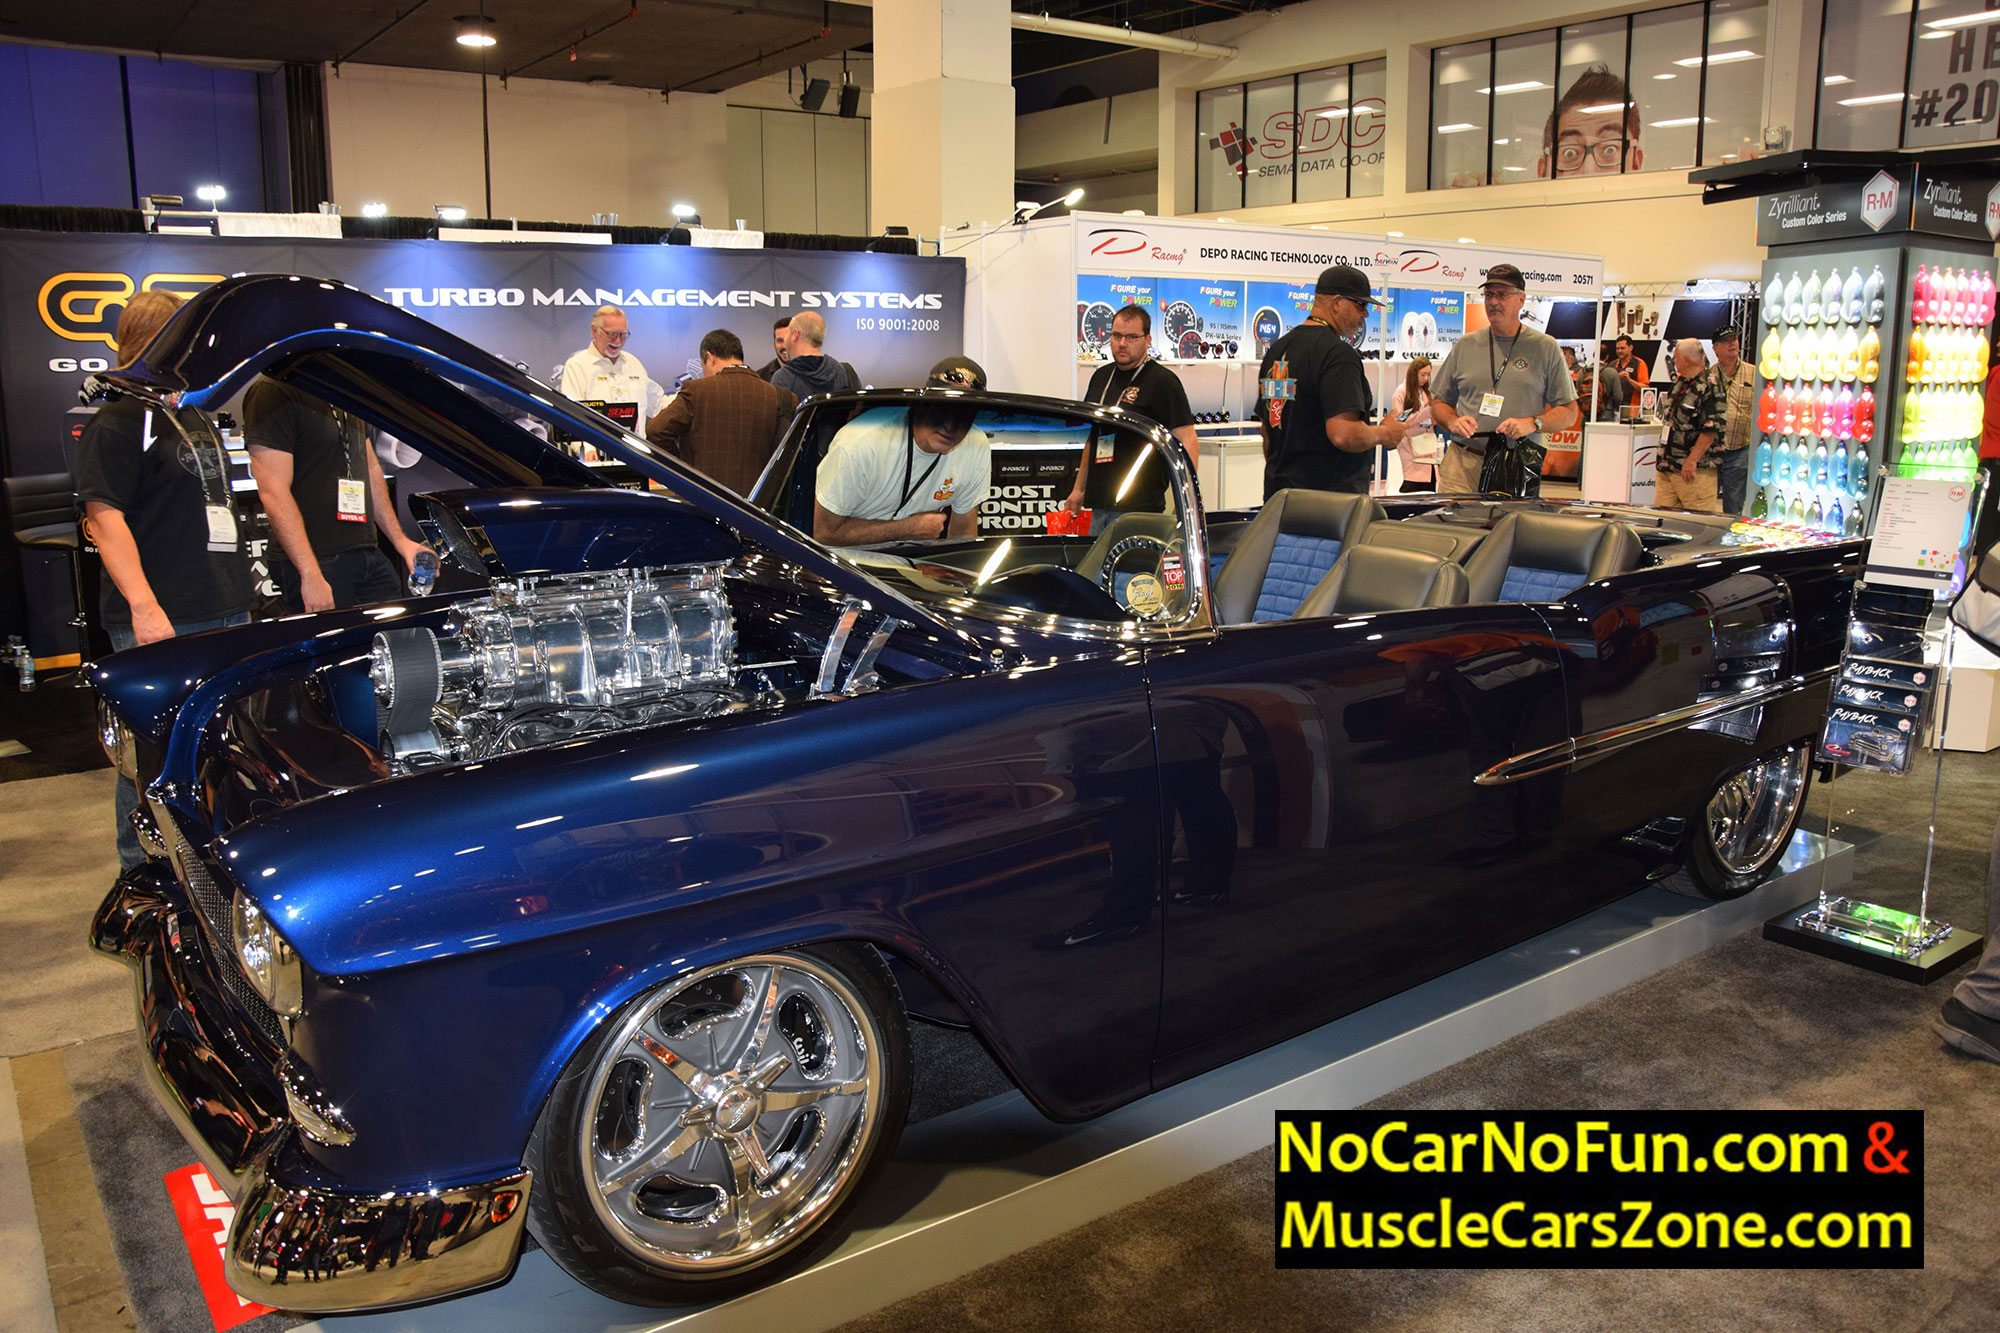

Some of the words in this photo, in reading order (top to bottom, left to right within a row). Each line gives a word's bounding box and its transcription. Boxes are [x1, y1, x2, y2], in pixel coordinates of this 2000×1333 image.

[1260, 97, 1386, 159] SDC
[1258, 164, 1296, 178] SEMA
[1300, 158, 1335, 173] DATA
[1768, 193, 1818, 219] Zyrilliant
[1866, 190, 1893, 211] R-M
[1781, 214, 1806, 229] Custom
[1807, 212, 1826, 226] Color
[1826, 210, 1847, 224] Series
[1933, 204, 1950, 218] Custom
[1951, 207, 1963, 221] Color
[1964, 209, 1978, 223] Series
[1200, 247, 1228, 259] DEPO
[1230, 249, 1268, 261] RACING
[1271, 251, 1333, 265] TECHNOLOGY
[1354, 257, 1373, 267] LTD.
[1573, 274, 1594, 285] 20571
[1110, 284, 1136, 293] FIGURE
[1137, 286, 1151, 295] your
[1200, 286, 1222, 296] FIGURE
[1223, 289, 1236, 297] your
[384, 288, 525, 307] TURBO
[532, 288, 796, 308] MANAGEMENT
[801, 290, 942, 309] SYSTEMS
[1121, 295, 1152, 306] POWER
[1209, 297, 1237, 308] POWER
[856, 318, 875, 331] ISO
[878, 318, 940, 331] 9001:2008
[49, 358, 108, 372] GO
[608, 407, 636, 418] SEMA
[1550, 431, 1580, 444] DW
[1164, 571, 1183, 583] TOP
[1848, 662, 1893, 679] PAYBACK
[1831, 707, 1878, 725] PAYBACK
